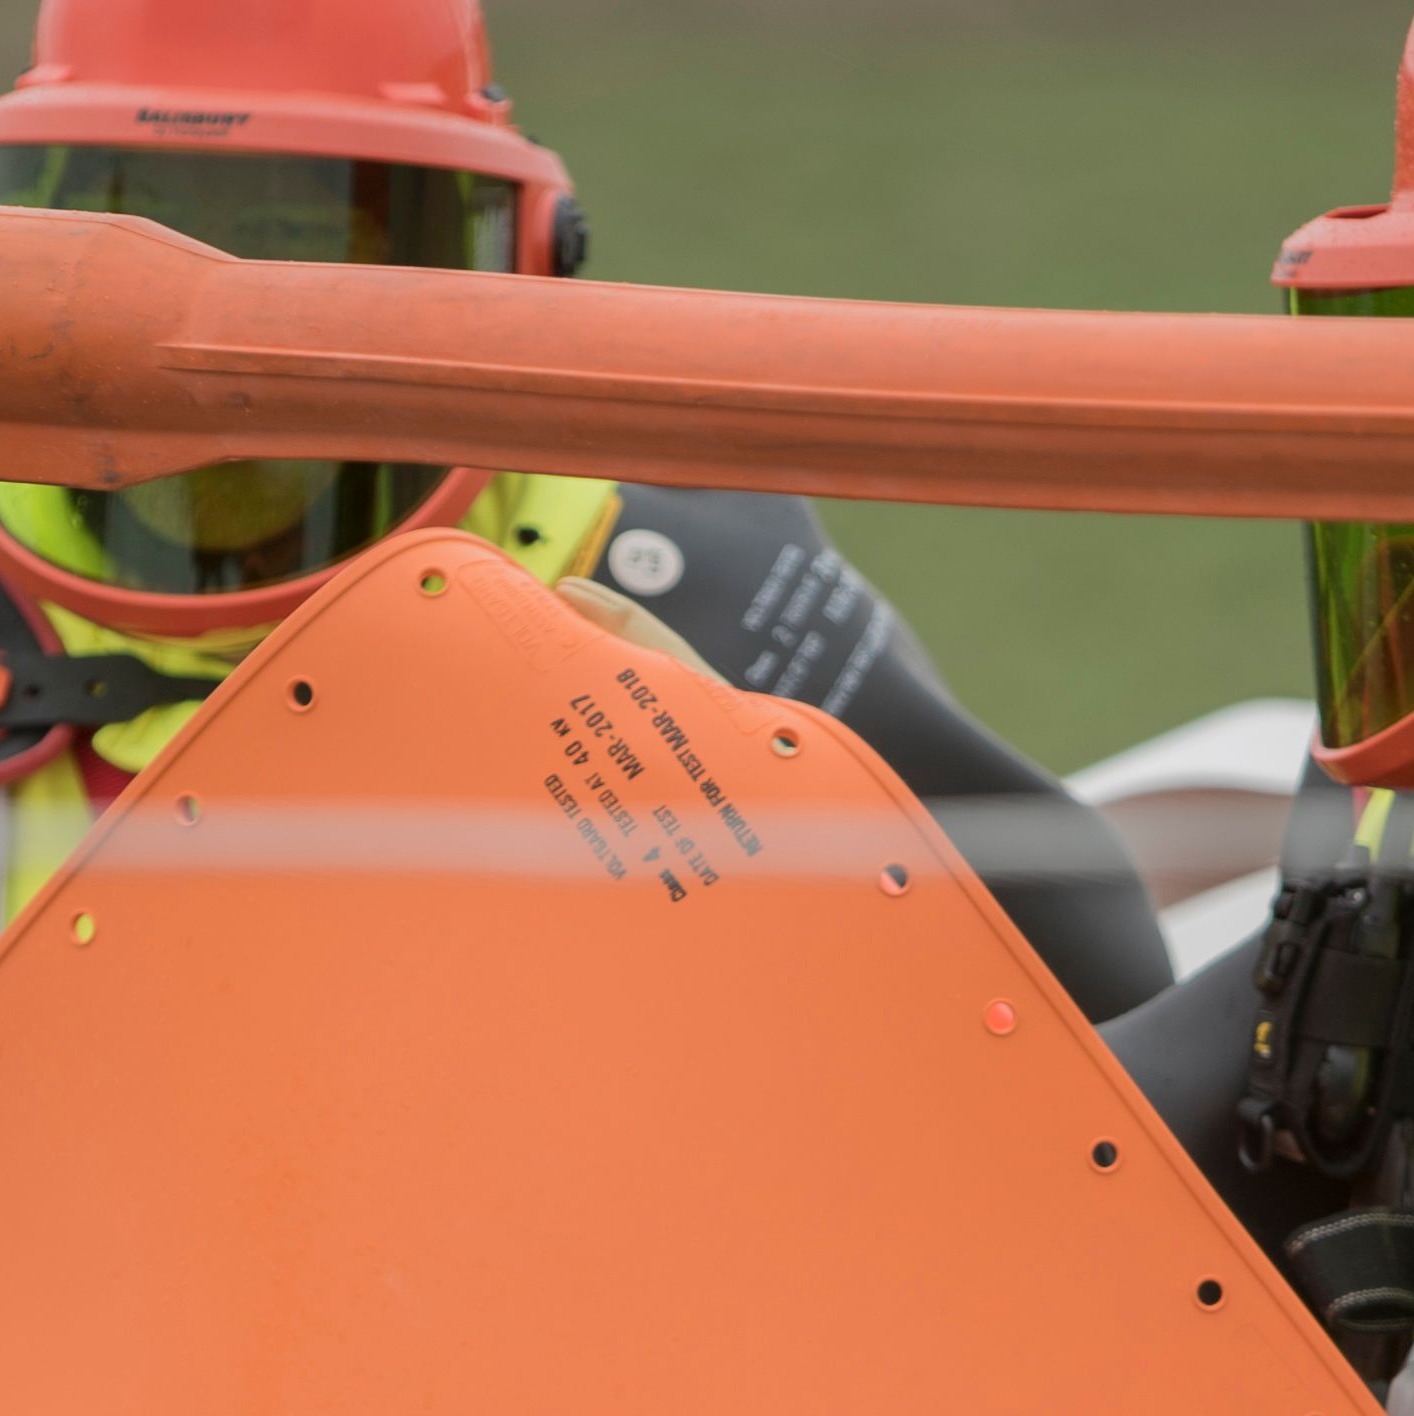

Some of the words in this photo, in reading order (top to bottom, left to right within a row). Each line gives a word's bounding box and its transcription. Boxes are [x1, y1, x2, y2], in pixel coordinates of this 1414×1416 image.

[616, 667, 689, 752] MAR-2018
[564, 740, 589, 766] 40
[569, 694, 645, 781] MAR-2017
[585, 772, 605, 790] AT
[676, 749, 707, 782] TEST
[544, 774, 582, 819] TESTED
[699, 777, 727, 807] FOR
[598, 789, 639, 837] TESTED
[652, 804, 681, 836] TEST
[718, 803, 764, 857] RETURN
[576, 817, 627, 880] VOLTGARD
[642, 846, 661, 863] 4
[675, 836, 696, 855] OF
[660, 868, 687, 903] Class
[688, 852, 720, 886] DATE
